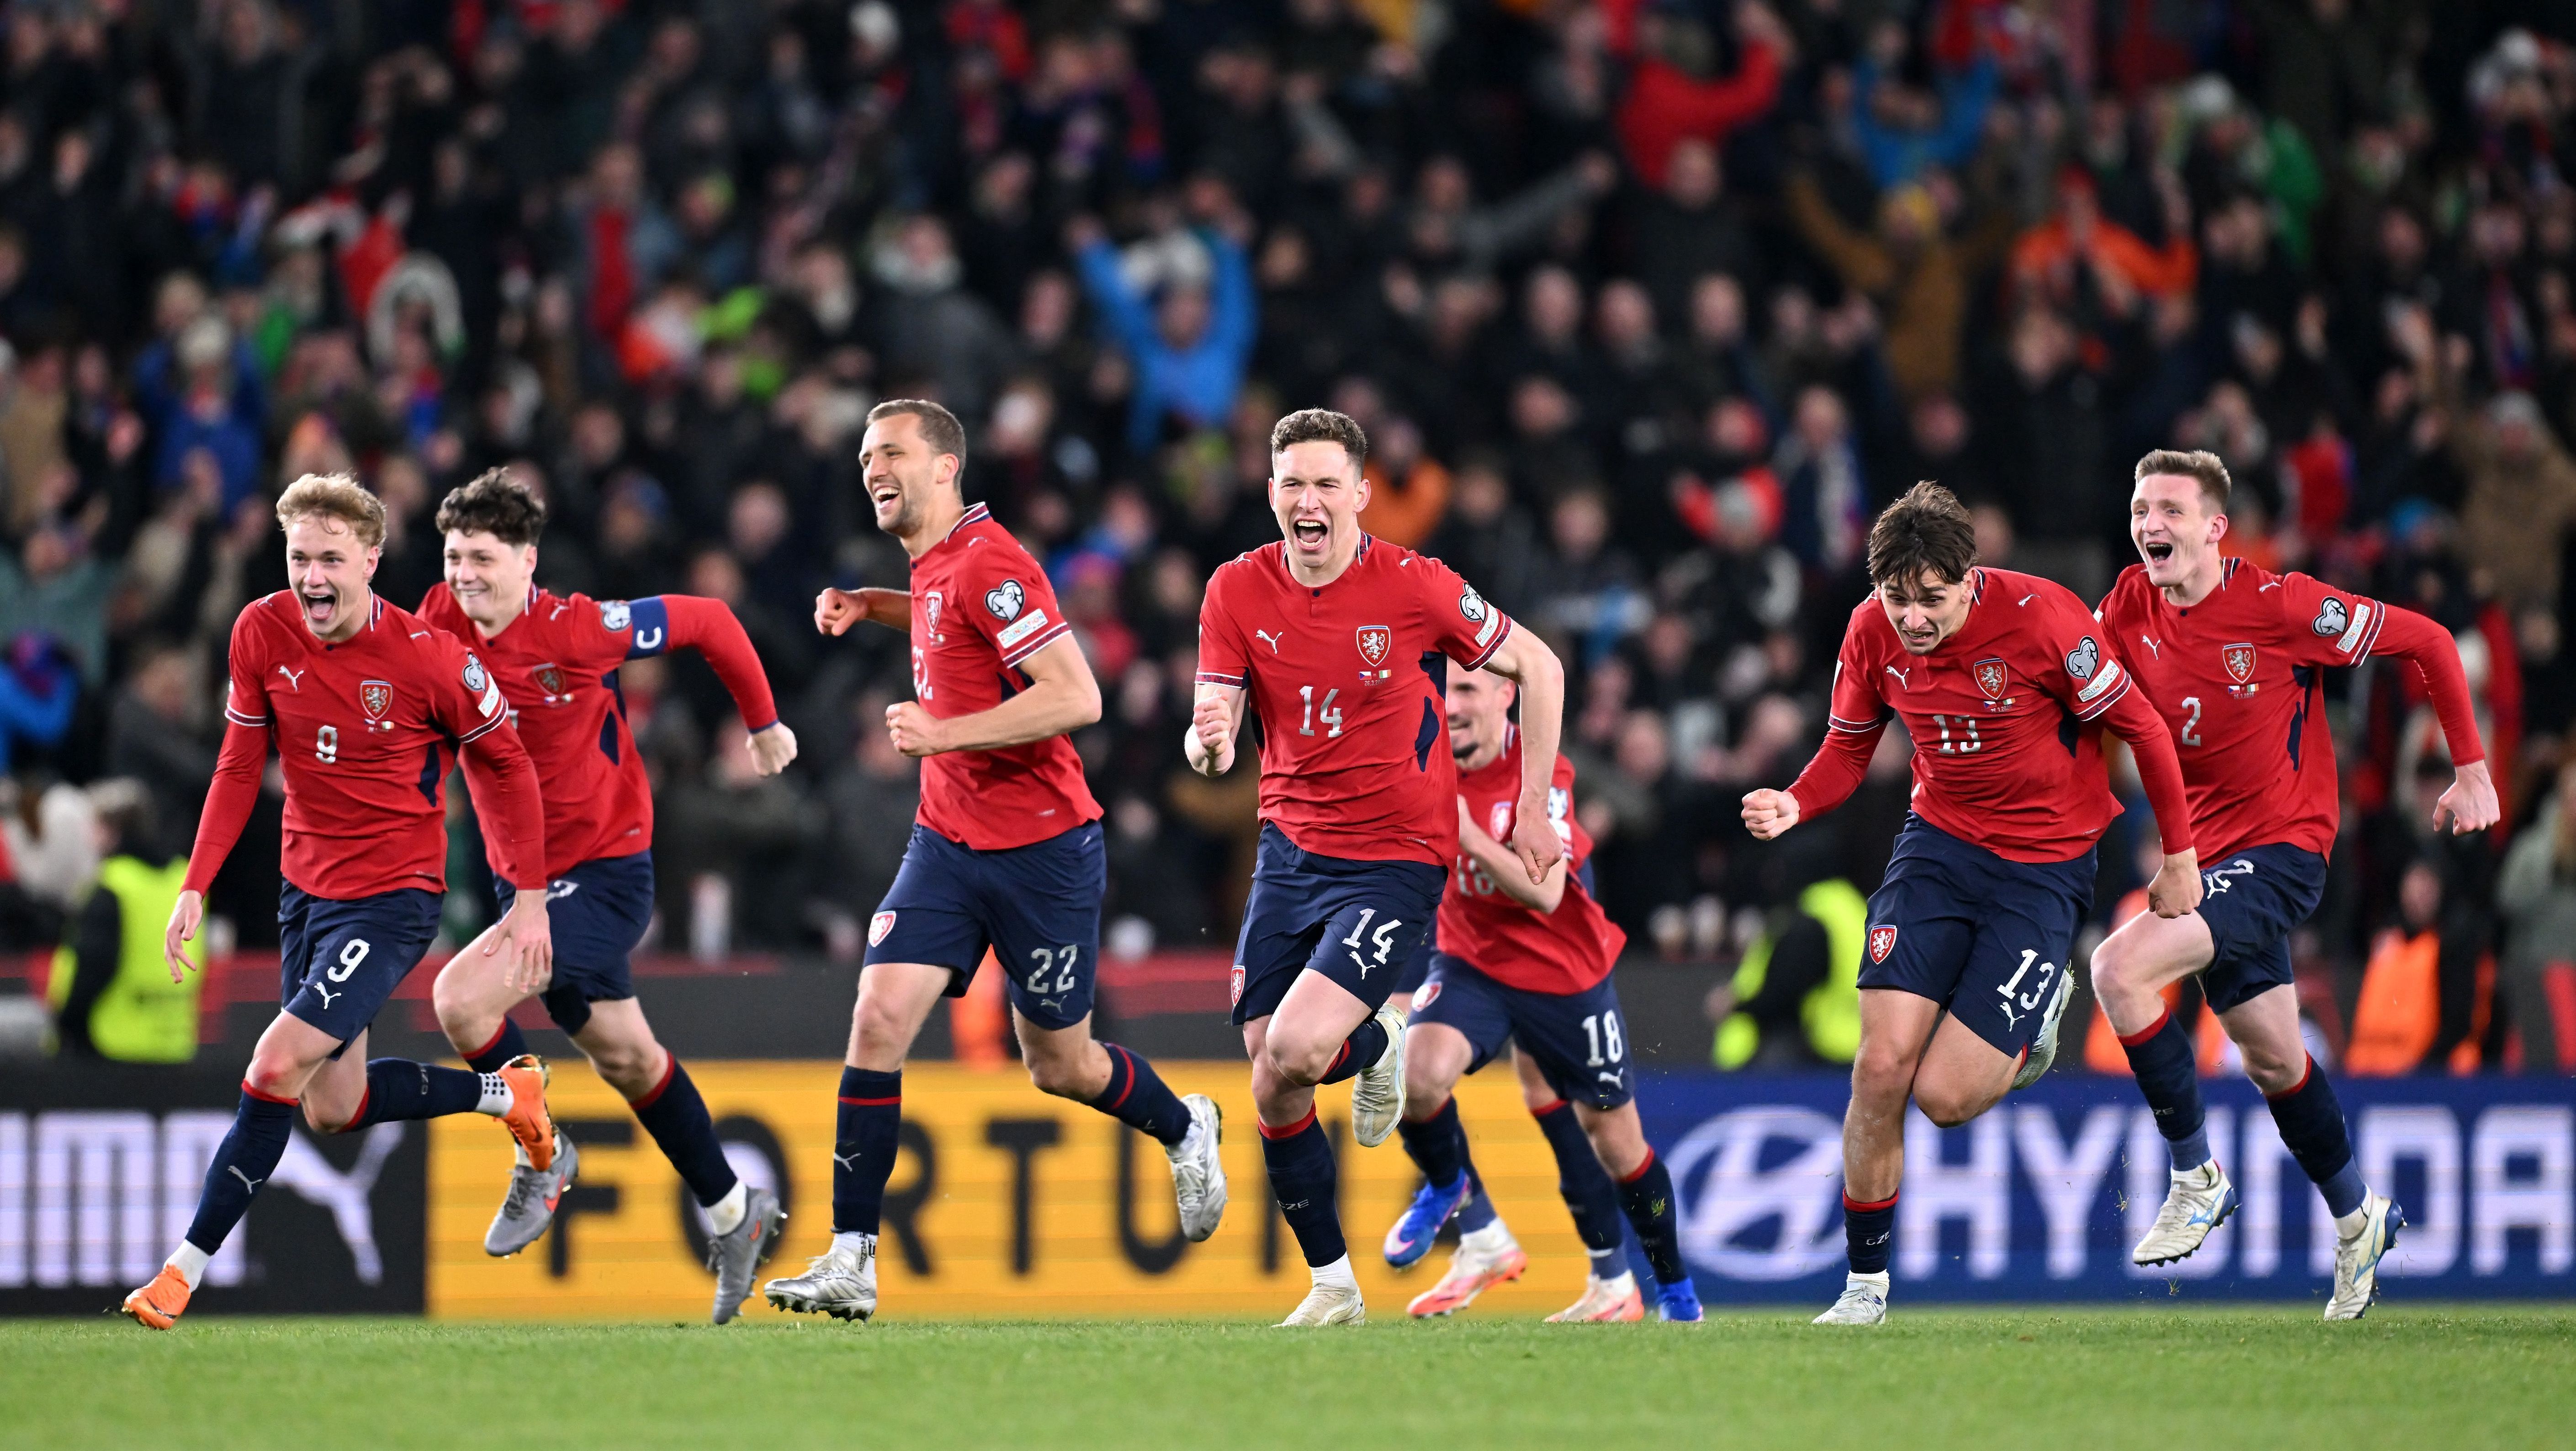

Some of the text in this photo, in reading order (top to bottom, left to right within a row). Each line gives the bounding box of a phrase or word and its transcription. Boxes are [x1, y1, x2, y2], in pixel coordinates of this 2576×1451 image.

[636, 626, 662, 649] C
[1001, 613, 1044, 641] FOUNDATION
[2340, 606, 2366, 650] FOUNDATION
[2081, 664, 2116, 699] FOUNDATION
[1299, 685, 1343, 738] 14
[2182, 696, 2201, 747] 2
[315, 725, 338, 764] 9
[1932, 715, 1982, 755] 13
[2211, 859, 2255, 889] 2
[1342, 908, 1403, 965] 14
[327, 938, 371, 984] 9
[1027, 943, 1078, 994] 22
[1996, 948, 2055, 1011] 13
[1581, 1009, 1623, 1068] 18
